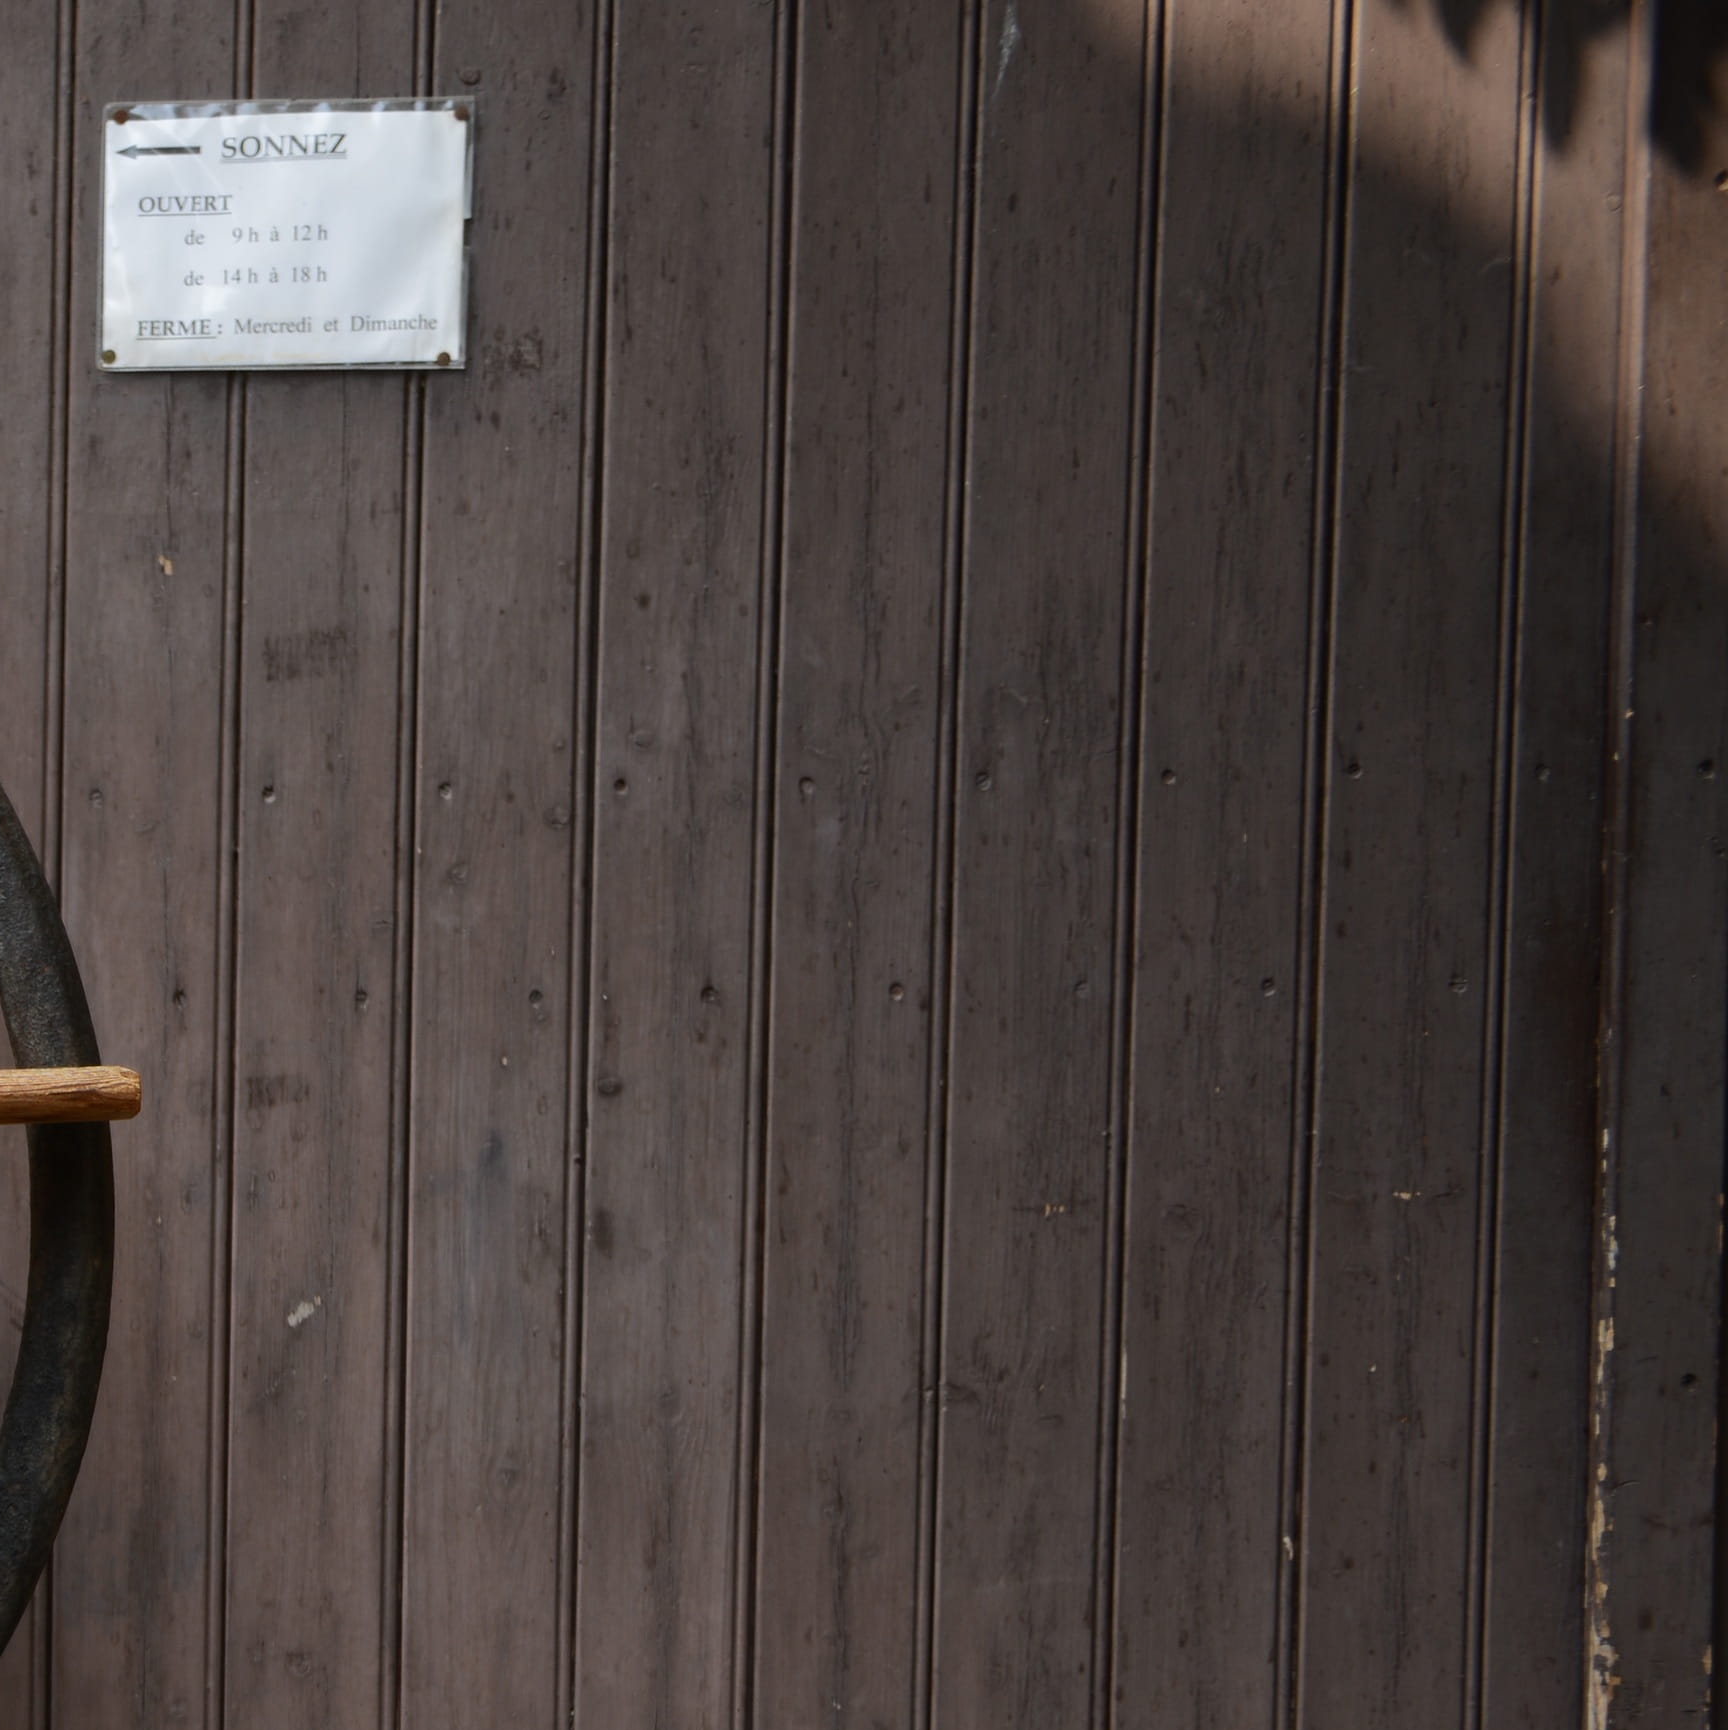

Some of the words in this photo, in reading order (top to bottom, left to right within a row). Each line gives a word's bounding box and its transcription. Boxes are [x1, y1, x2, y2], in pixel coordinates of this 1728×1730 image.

[221, 134, 347, 159] SONNEZ
[138, 195, 232, 213] OUVERT
[184, 229, 205, 246] de
[269, 226, 280, 242] à
[183, 271, 205, 287] de
[269, 267, 279, 283] à
[234, 316, 312, 335] Mercredi
[323, 318, 339, 333] et
[350, 313, 438, 333] Dimanche
